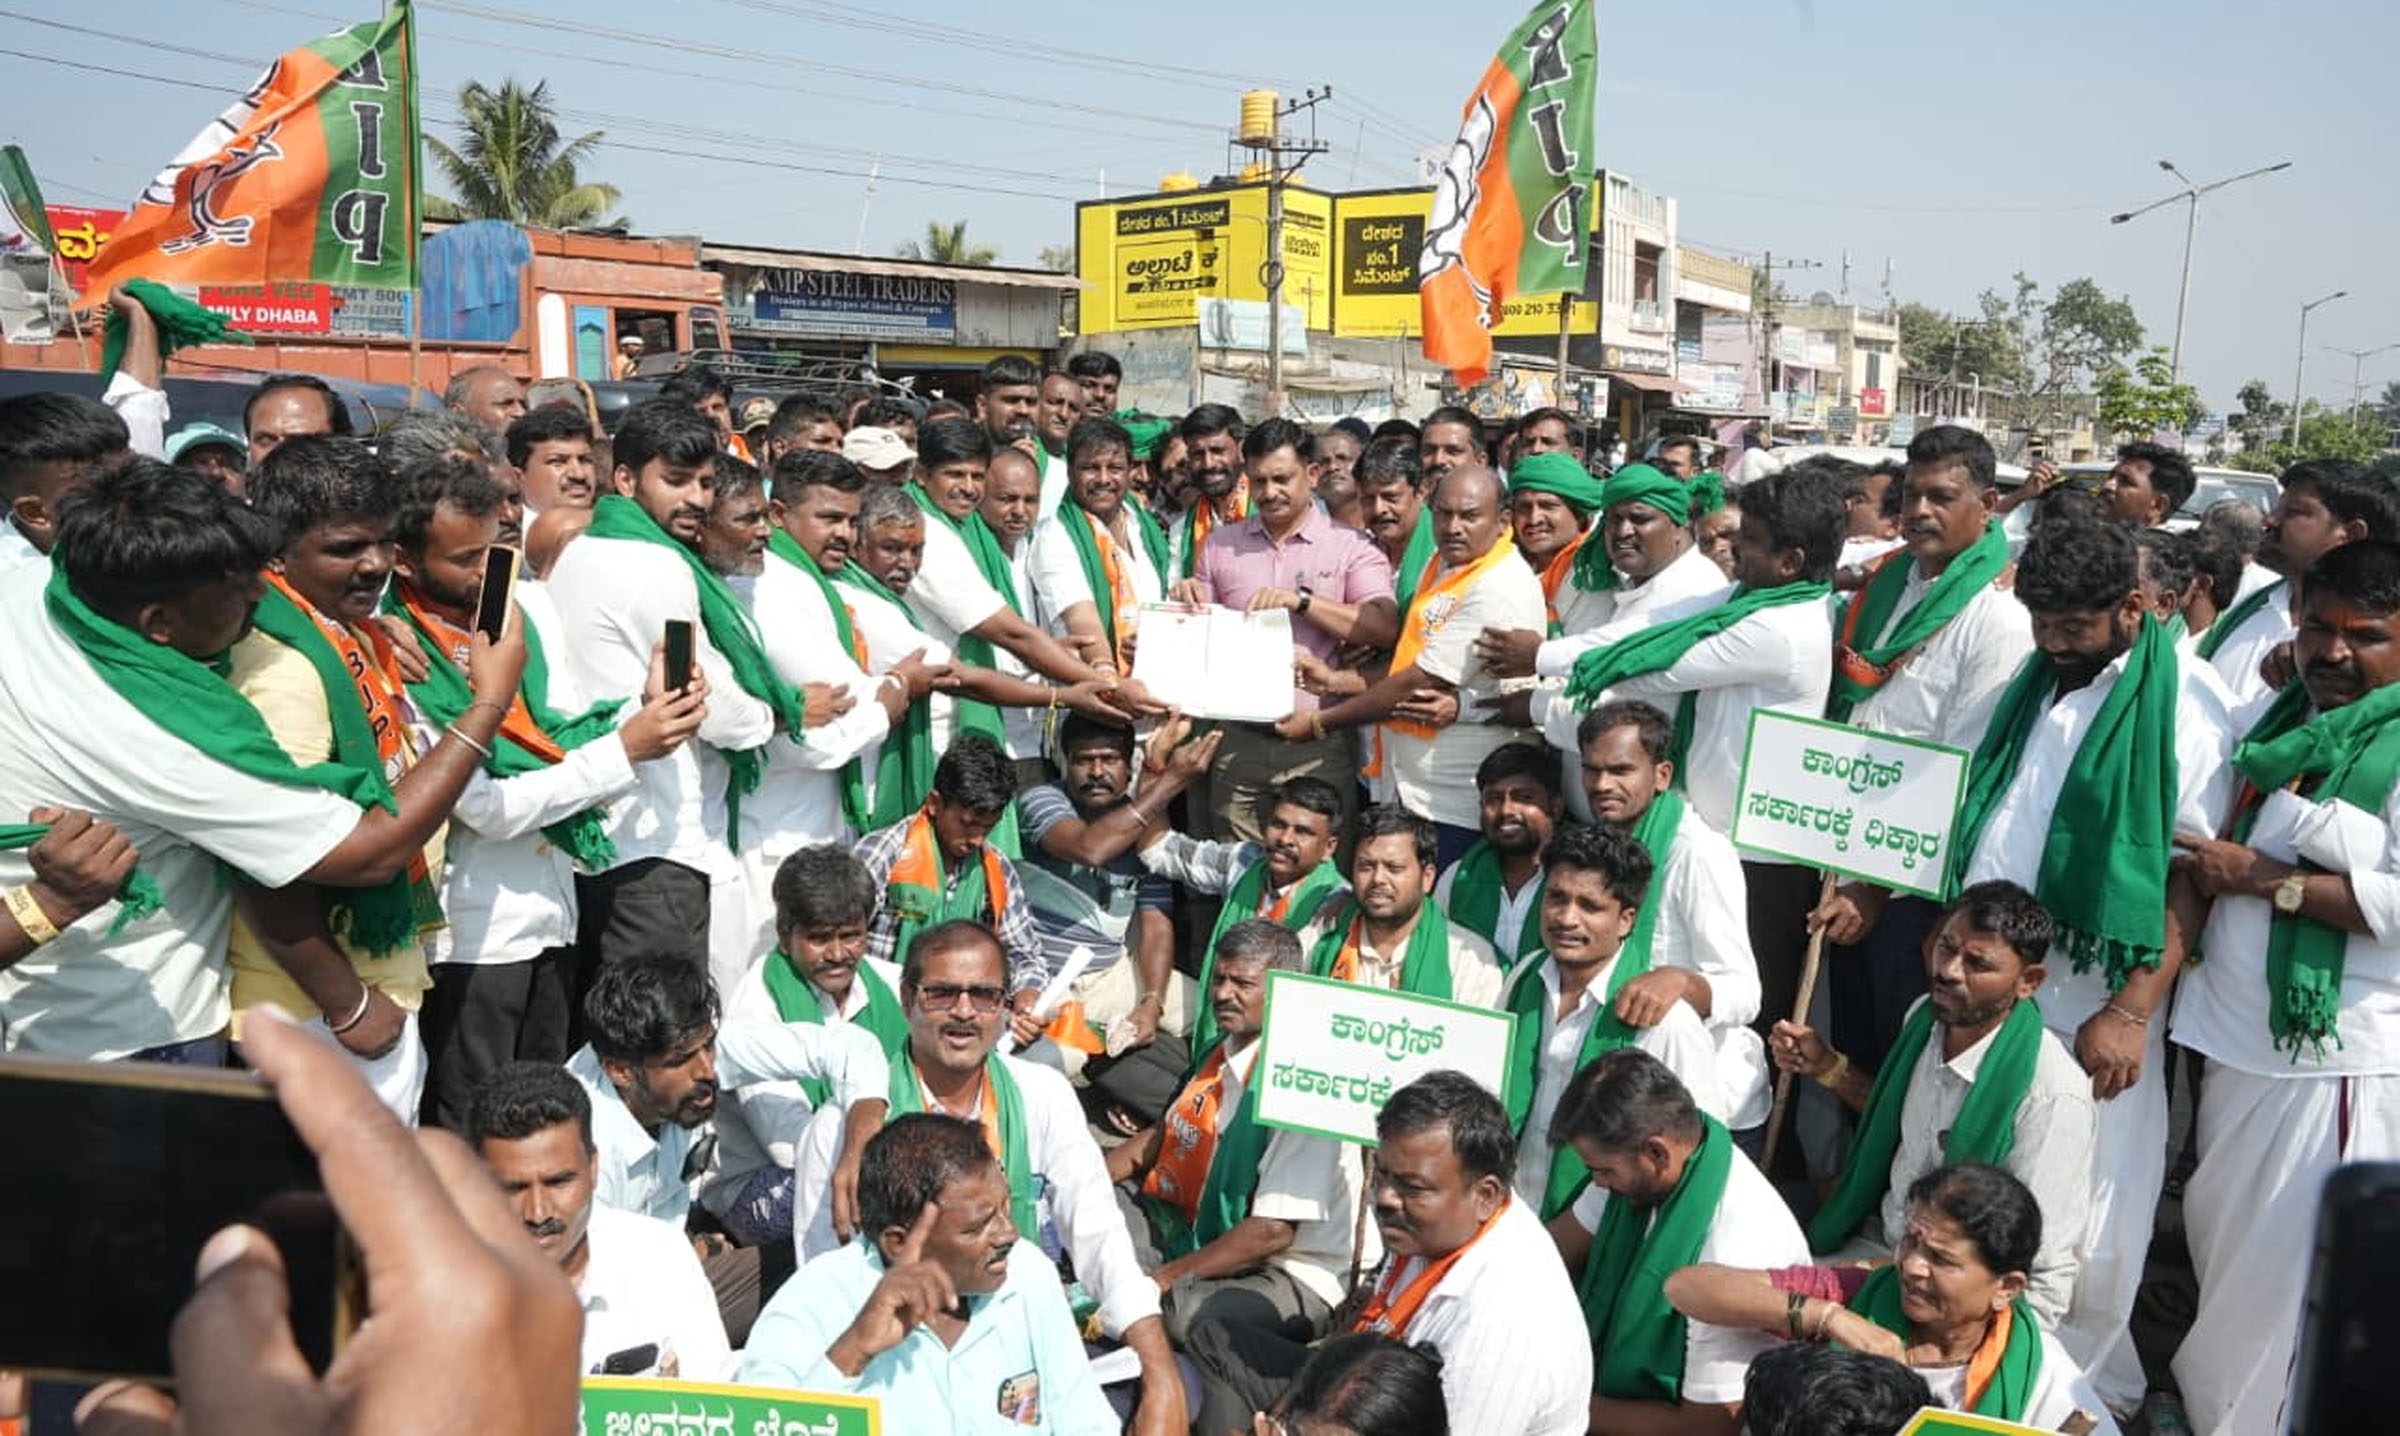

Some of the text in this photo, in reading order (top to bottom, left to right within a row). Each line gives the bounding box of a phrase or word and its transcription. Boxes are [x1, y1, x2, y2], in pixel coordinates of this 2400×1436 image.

[1362, 223, 1404, 242] ದೇಶದ
[1366, 243, 1399, 266] ನಂ.1
[808, 272, 867, 298] STEEL
[870, 275, 951, 303] TRADERS
[1353, 266, 1411, 285] ಸಿಮೆಂಟ್
[256, 308, 318, 324] DHABA
[1802, 748, 1904, 793] ಕಾಂಗ್ರೆಸ್
[1748, 789, 1941, 869] ಸರ್ಕಾರಕ್ಕೆ ಧಿಕ್ಕಾರ
[1331, 1012, 1445, 1061] ಕಾಂಗ್ರೆಸ್
